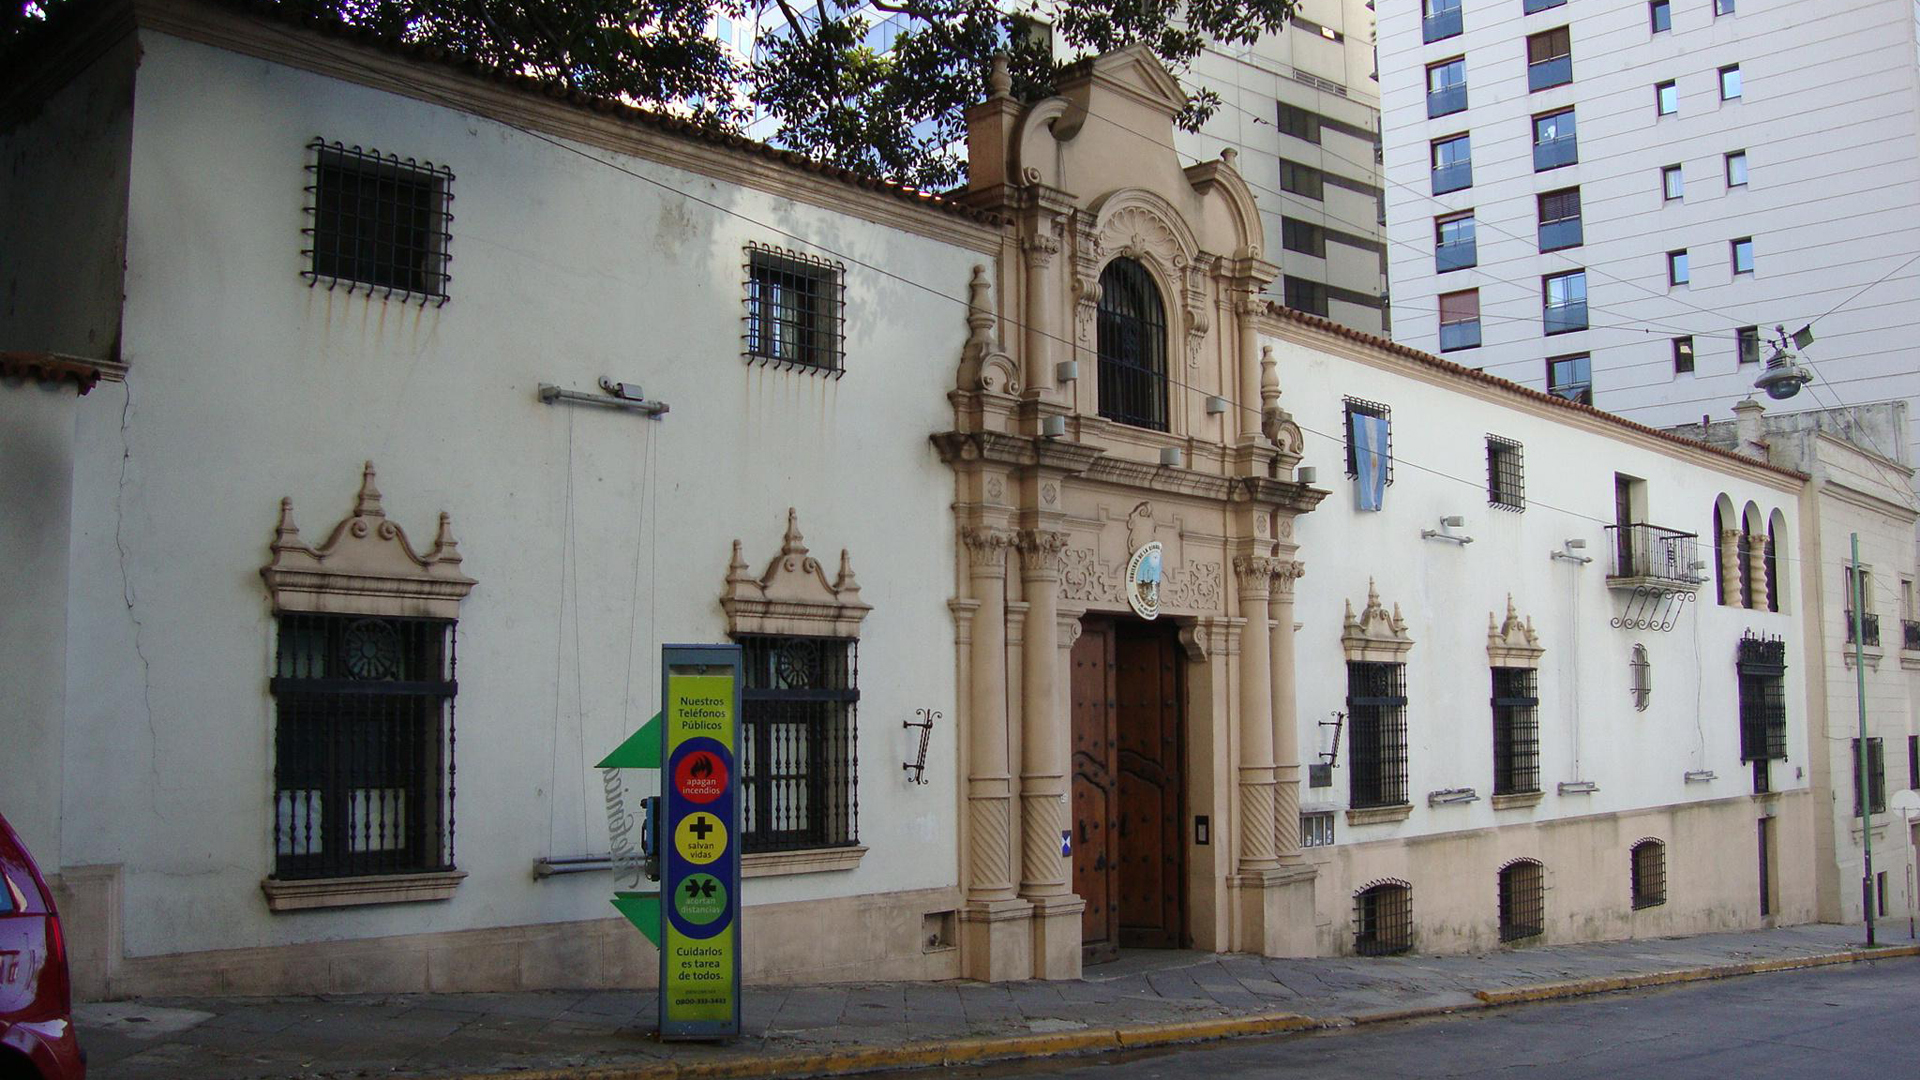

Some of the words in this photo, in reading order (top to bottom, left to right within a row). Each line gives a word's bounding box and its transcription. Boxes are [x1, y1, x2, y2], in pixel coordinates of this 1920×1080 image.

[680, 696, 725, 706] Nuestros
[678, 708, 726, 718] Teléfonos
[681, 720, 723, 730] Públicos
[686, 778, 717, 788] apagan
[682, 787, 721, 795] incendios
[688, 842, 714, 850] salvan
[690, 850, 712, 859] vidas
[685, 897, 717, 905] acortan
[680, 905, 721, 914] distancias
[676, 946, 723, 956] Cuidarlos
[681, 960, 692, 969] es
[694, 959, 720, 969] tarea
[678, 971, 691, 981] de
[693, 971, 724, 981] todos.
